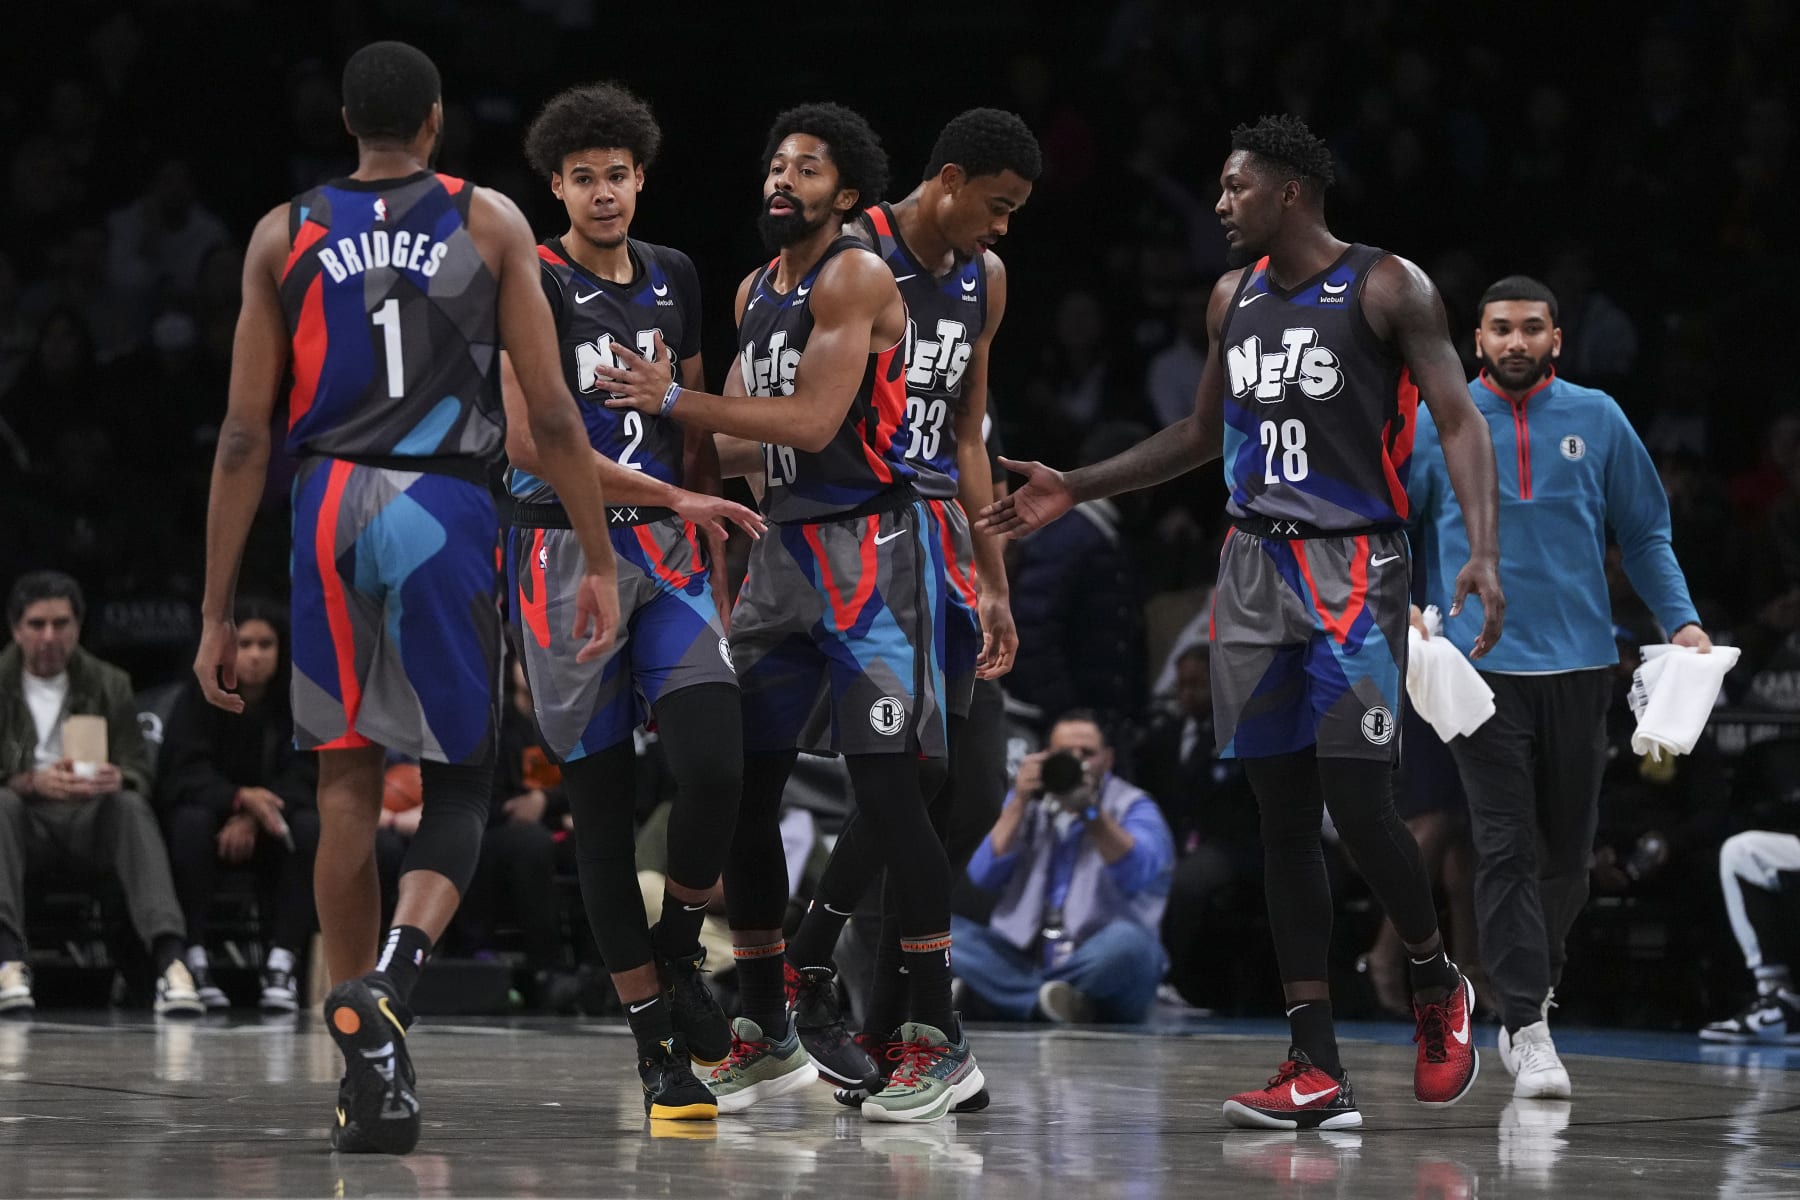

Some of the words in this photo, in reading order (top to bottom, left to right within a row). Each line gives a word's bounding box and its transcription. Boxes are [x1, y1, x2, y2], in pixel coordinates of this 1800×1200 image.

[317, 230, 449, 284] BRIDGES
[1320, 296, 1344, 304] Webull
[372, 298, 405, 399] 1
[1227, 327, 1345, 404] NETS
[617, 410, 644, 470] 2
[905, 396, 947, 461] 33
[1260, 418, 1309, 485] 28
